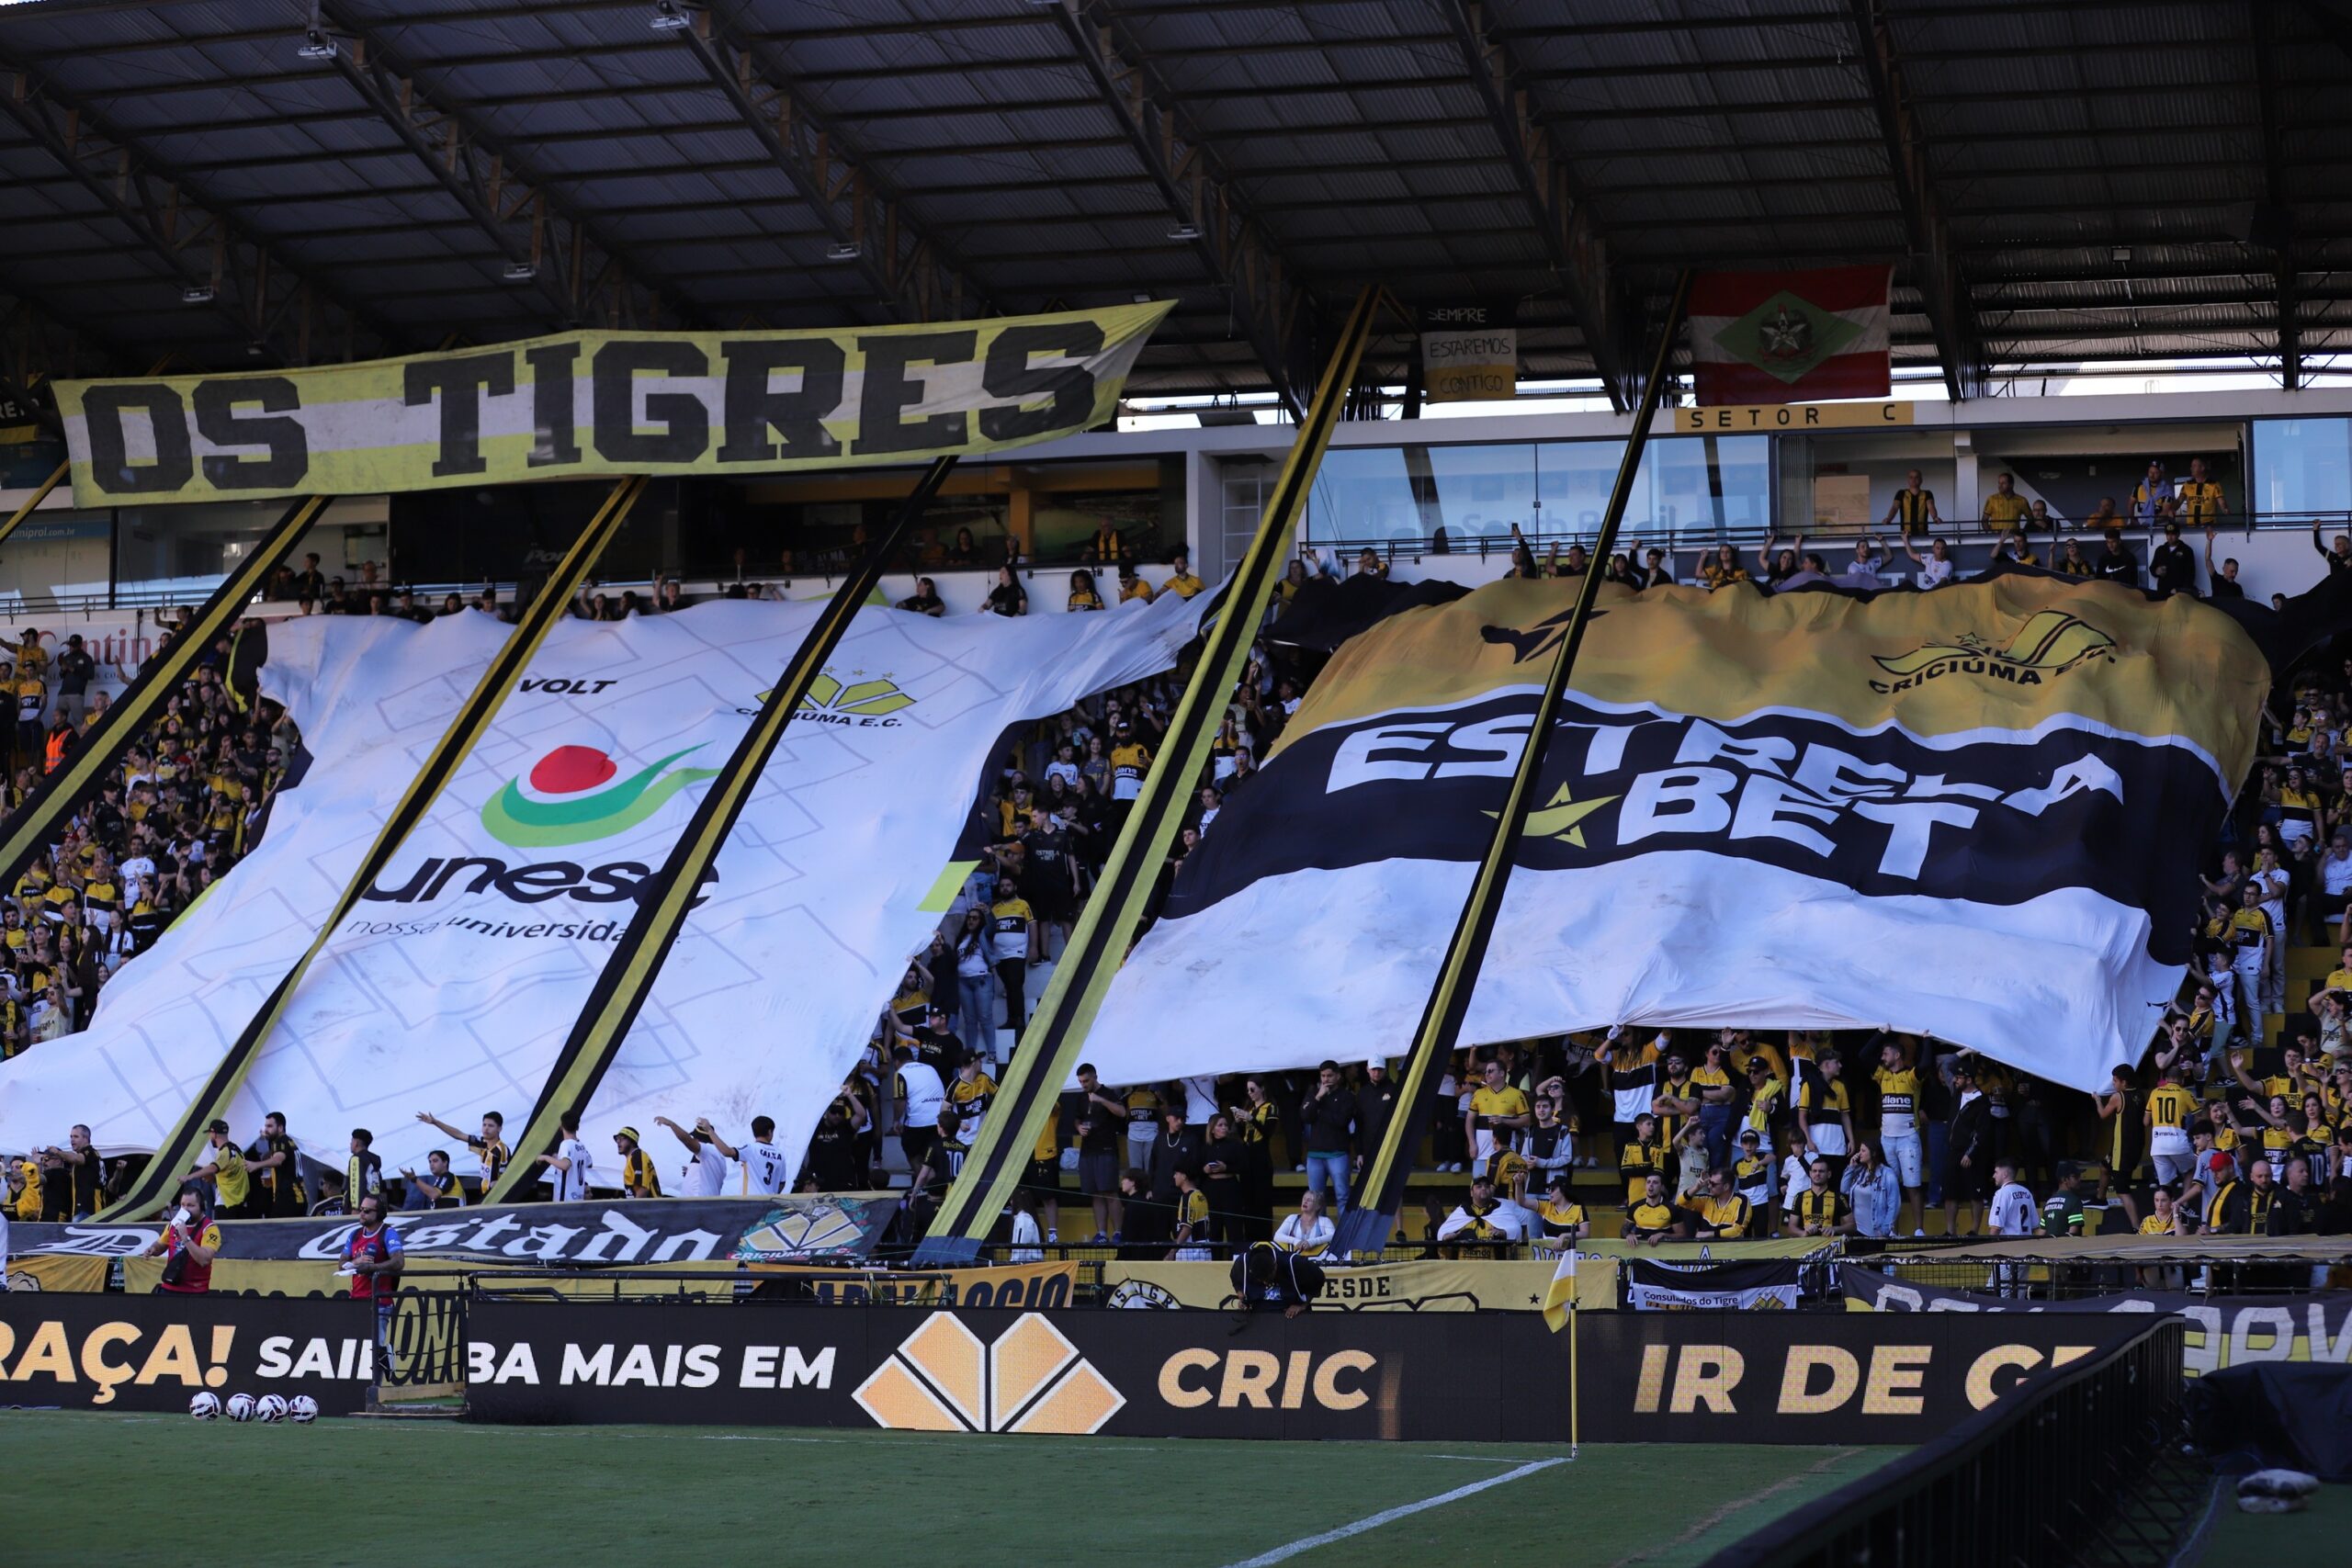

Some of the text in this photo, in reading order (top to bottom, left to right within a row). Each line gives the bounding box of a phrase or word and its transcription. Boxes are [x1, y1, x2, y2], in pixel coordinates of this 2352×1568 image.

[1426, 308, 1487, 323] SEMPRE
[1429, 337, 1512, 358] ESTAREMOS
[1440, 373, 1504, 395] CONTIGO
[82, 320, 1105, 494] OS TIGRES
[1690, 404, 1896, 429] SETOR C
[1462, 512, 1560, 534] South
[518, 678, 618, 696] VOLT
[1868, 657, 2042, 694] CRICIÚMA
[859, 717, 903, 728] E.C.
[1325, 713, 2124, 817] ESTRELA
[1615, 768, 1980, 880] BET
[346, 920, 440, 936] nossa
[2156, 1097, 2177, 1124] 10
[763, 1161, 775, 1186] 3
[945, 1150, 965, 1178] 10
[2019, 1203, 2029, 1233] 2
[1317, 1275, 1391, 1299] ESDE
[1644, 1292, 1739, 1307] Consulados do Tigre
[0, 1320, 237, 1405] AÇA!
[560, 1343, 721, 1389] MAIS
[738, 1345, 837, 1391] EM
[1158, 1343, 2097, 1416] CRIC IR DE G
